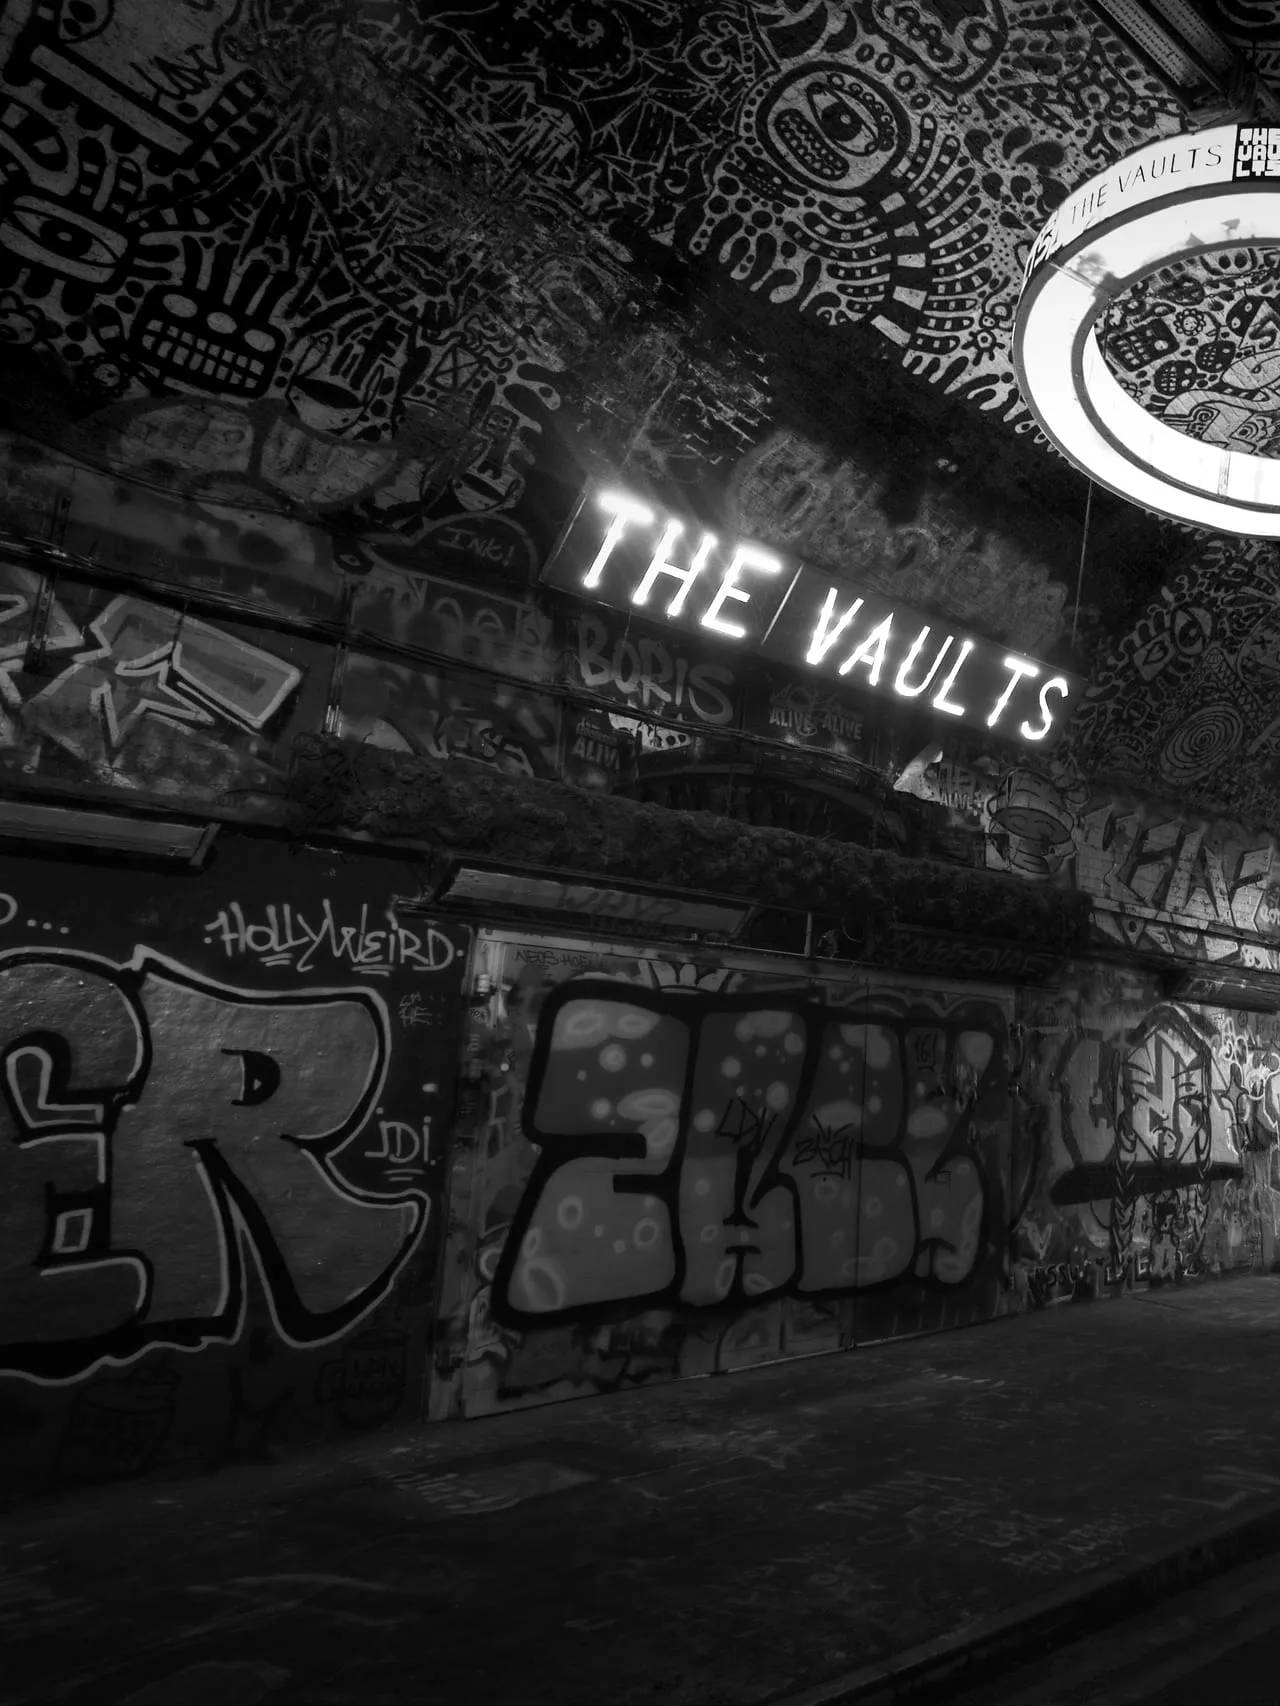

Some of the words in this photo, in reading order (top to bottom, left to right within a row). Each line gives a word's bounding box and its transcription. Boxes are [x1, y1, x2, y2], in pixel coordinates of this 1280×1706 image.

[1071, 183, 1108, 225] THE
[1118, 143, 1224, 193] VAULTS
[577, 612, 736, 726] BORIS
[583, 493, 782, 639] THE
[805, 586, 1069, 740] VAULTS
